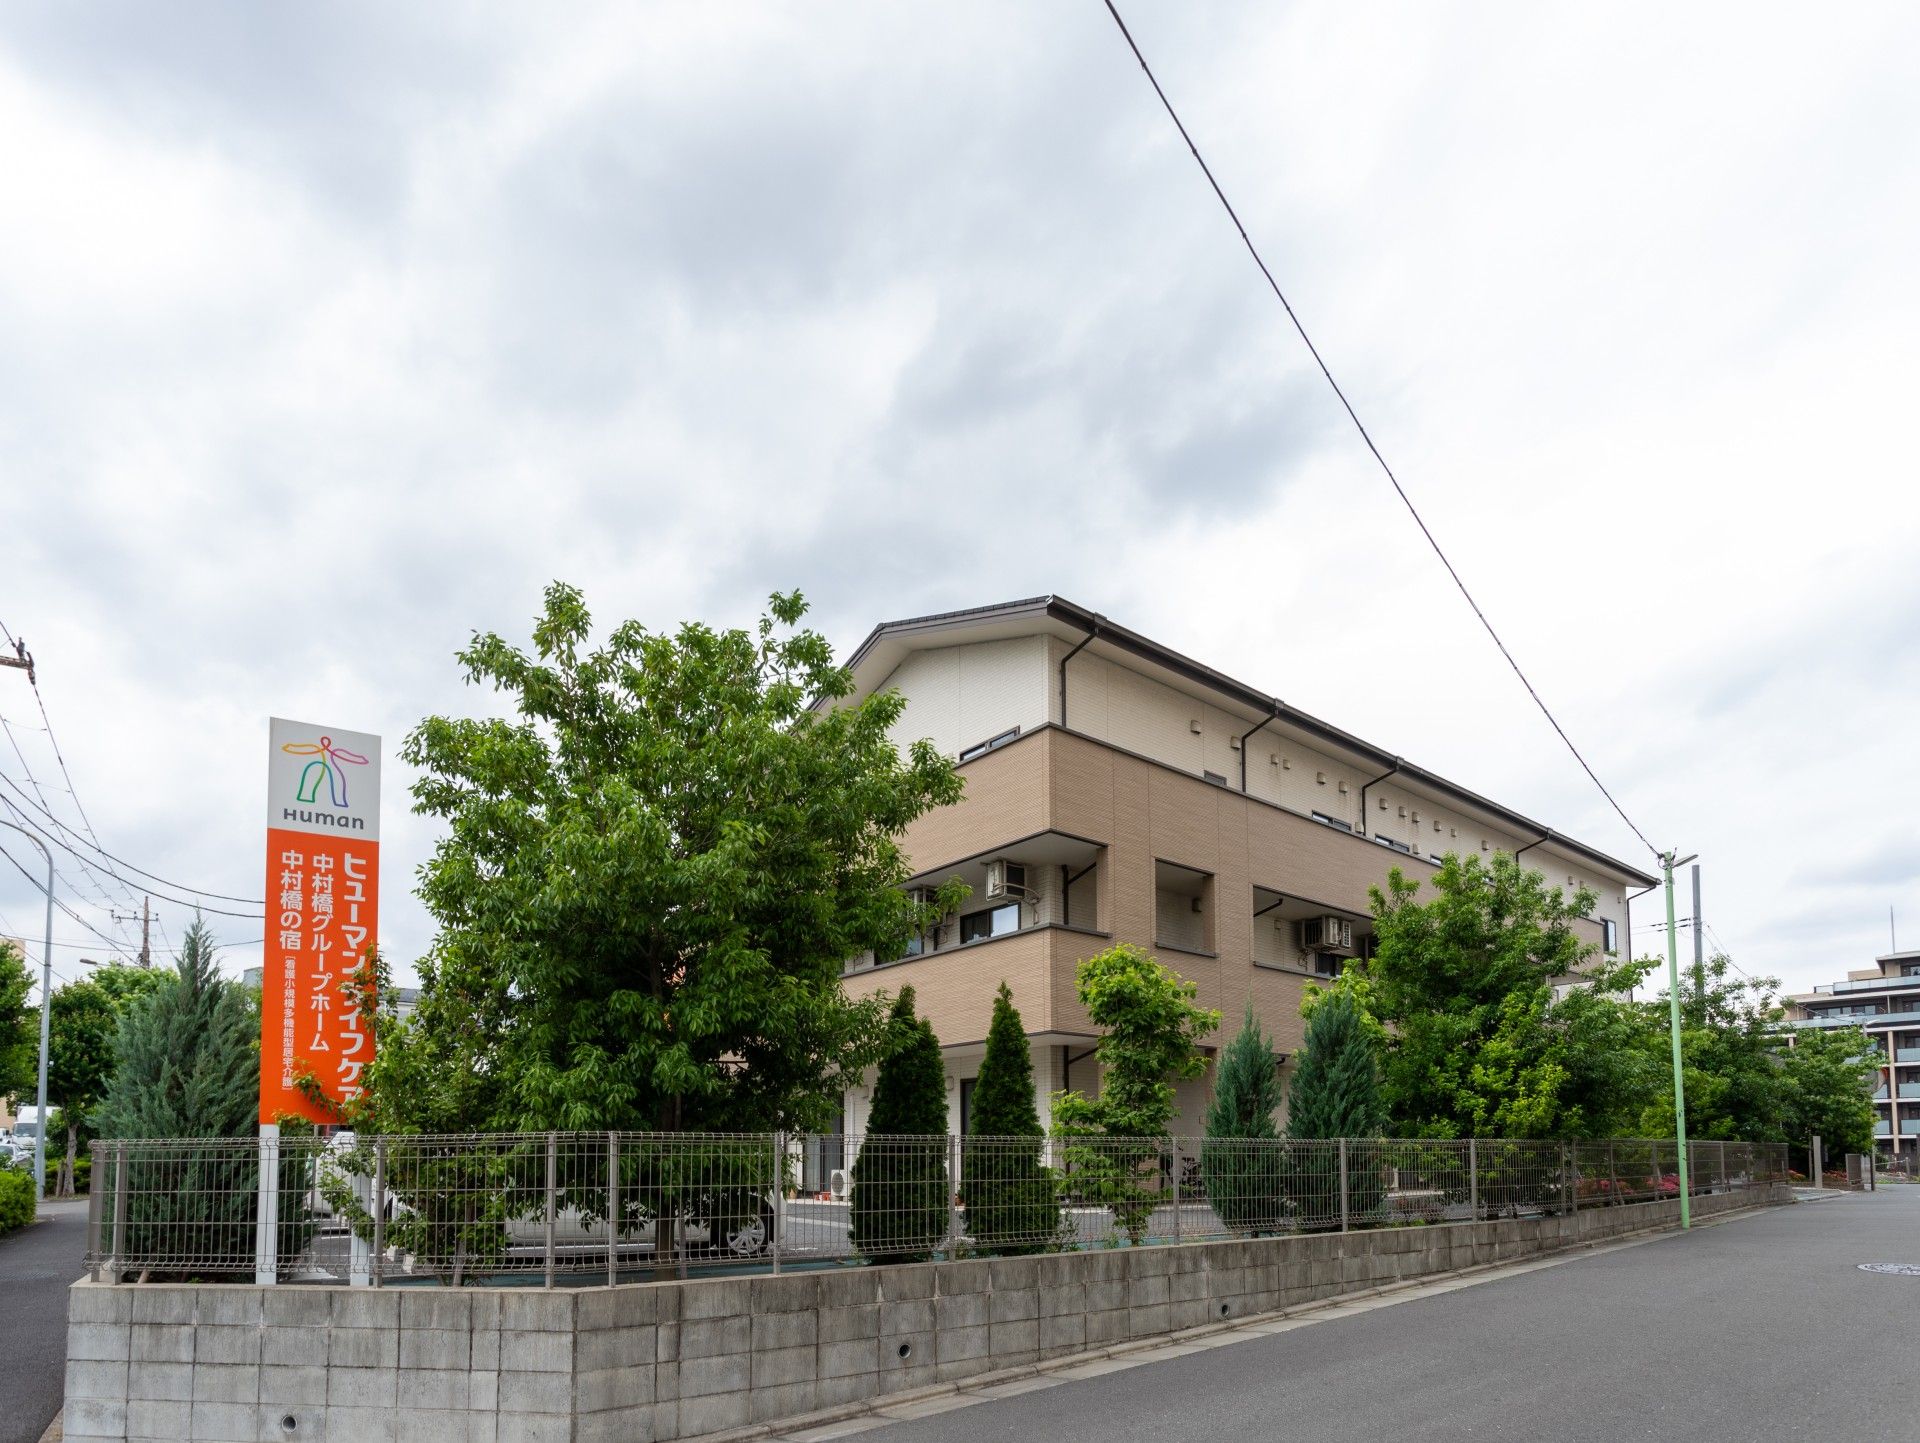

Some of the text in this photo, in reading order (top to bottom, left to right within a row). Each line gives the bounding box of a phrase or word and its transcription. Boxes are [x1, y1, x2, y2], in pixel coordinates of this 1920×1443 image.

[283, 808, 364, 830] Human
[279, 849, 304, 951] 中村橋の宿
[309, 853, 334, 1052] 中村橋グループホーム
